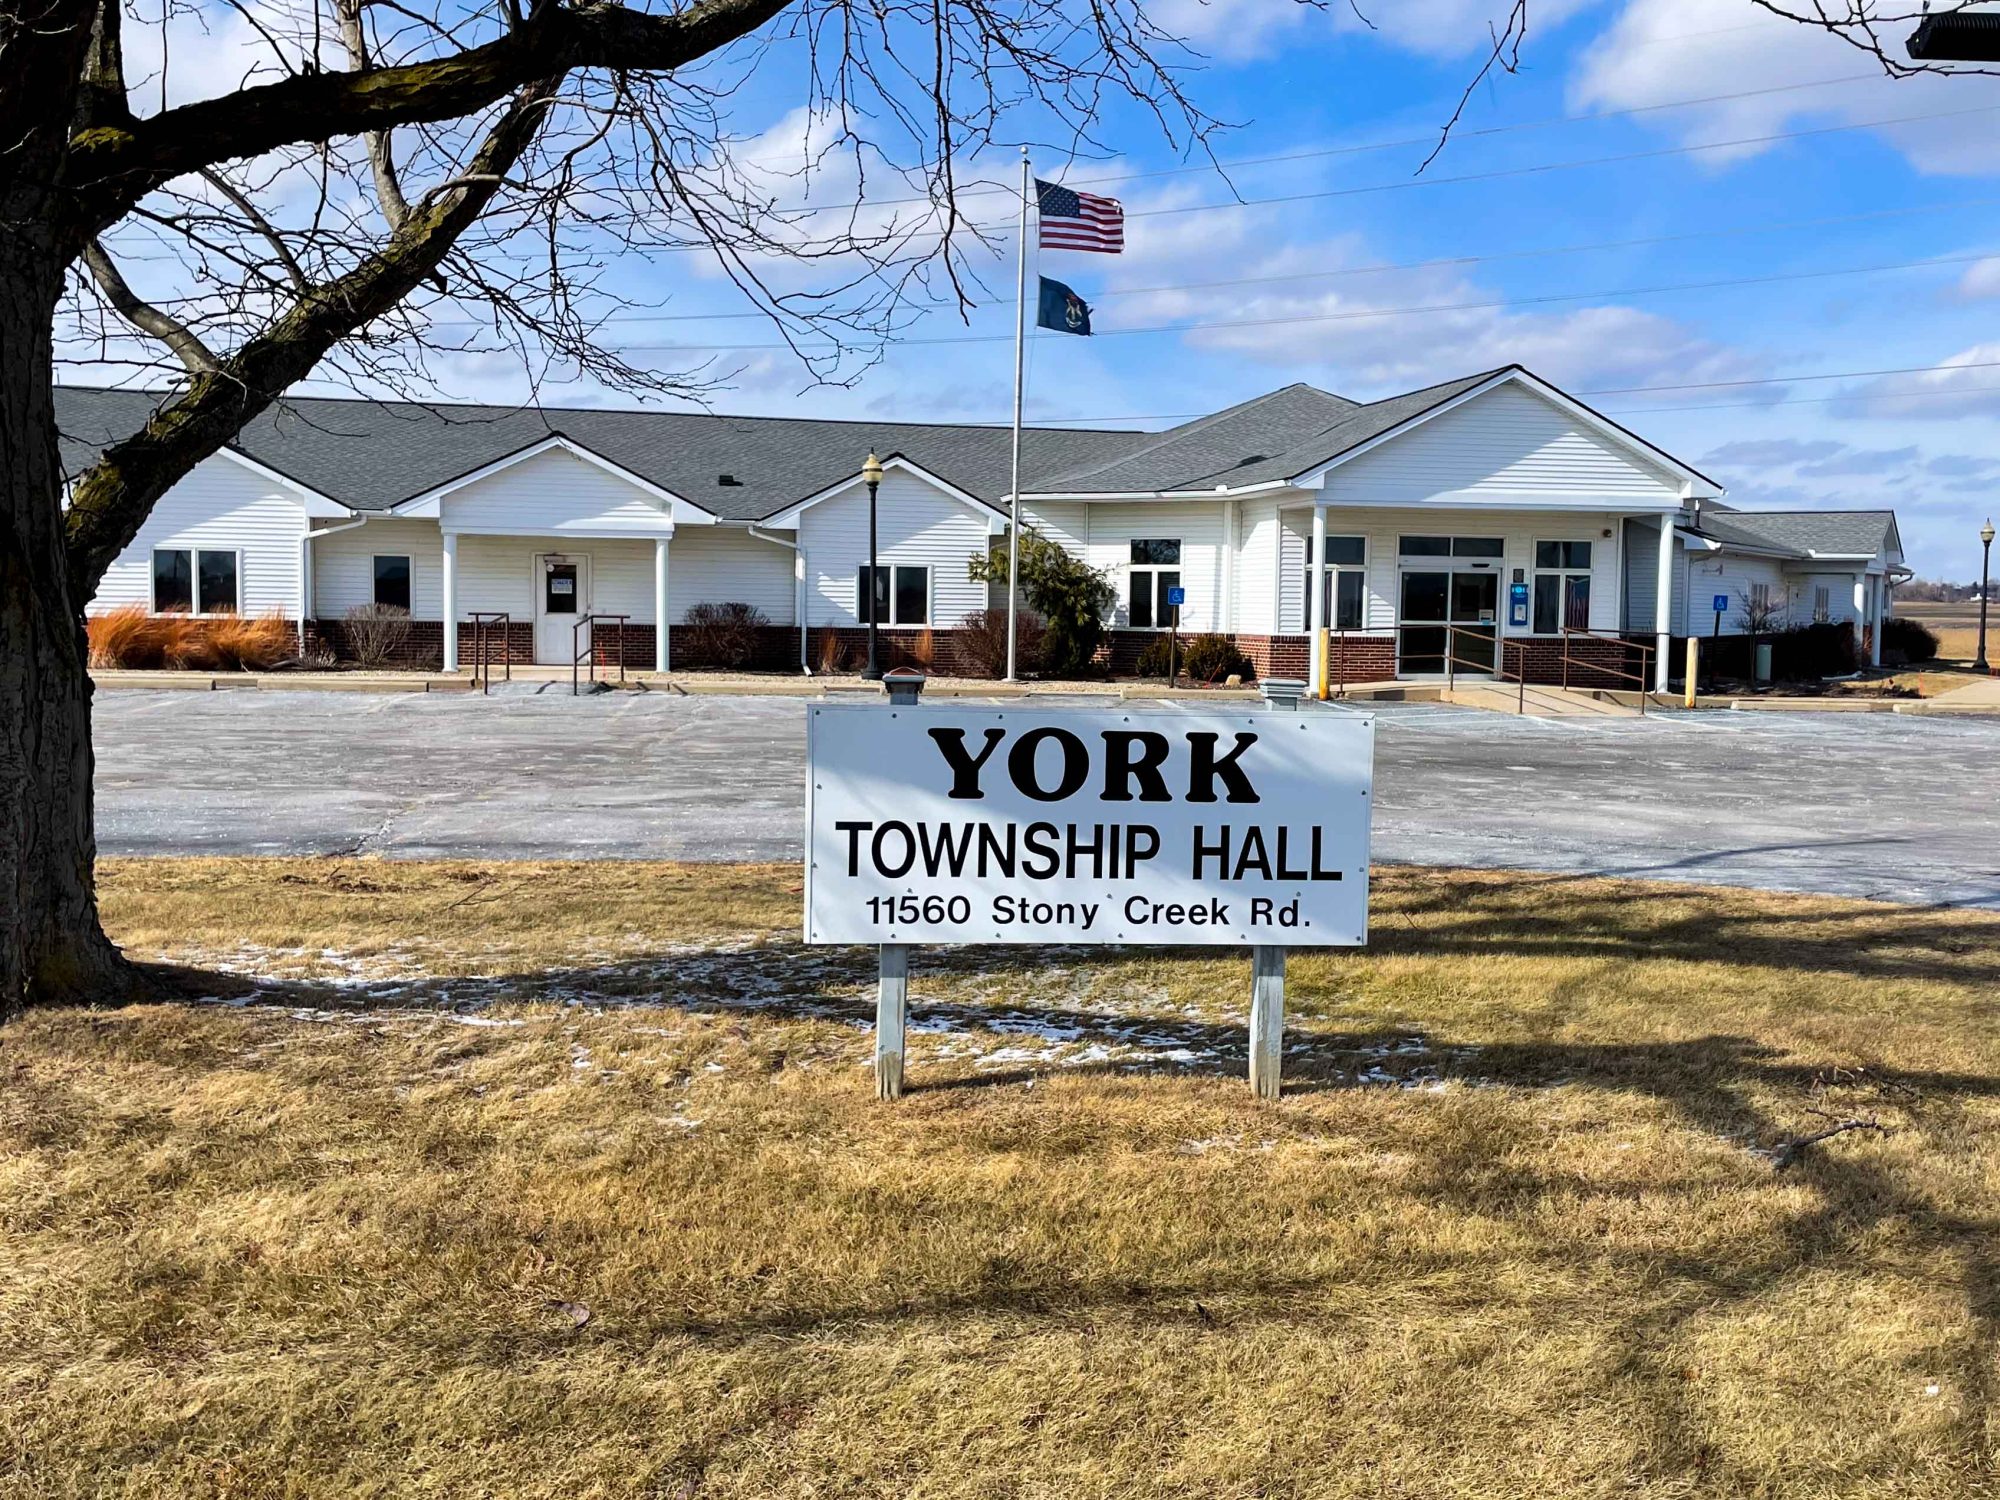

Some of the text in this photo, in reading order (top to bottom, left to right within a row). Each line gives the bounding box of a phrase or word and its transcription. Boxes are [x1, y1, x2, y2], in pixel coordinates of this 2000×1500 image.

[927, 726, 1261, 804] YORK
[835, 820, 1343, 881] TOWNSHIP HALL
[866, 895, 1311, 930] 11560 Stony Creek Rd.
